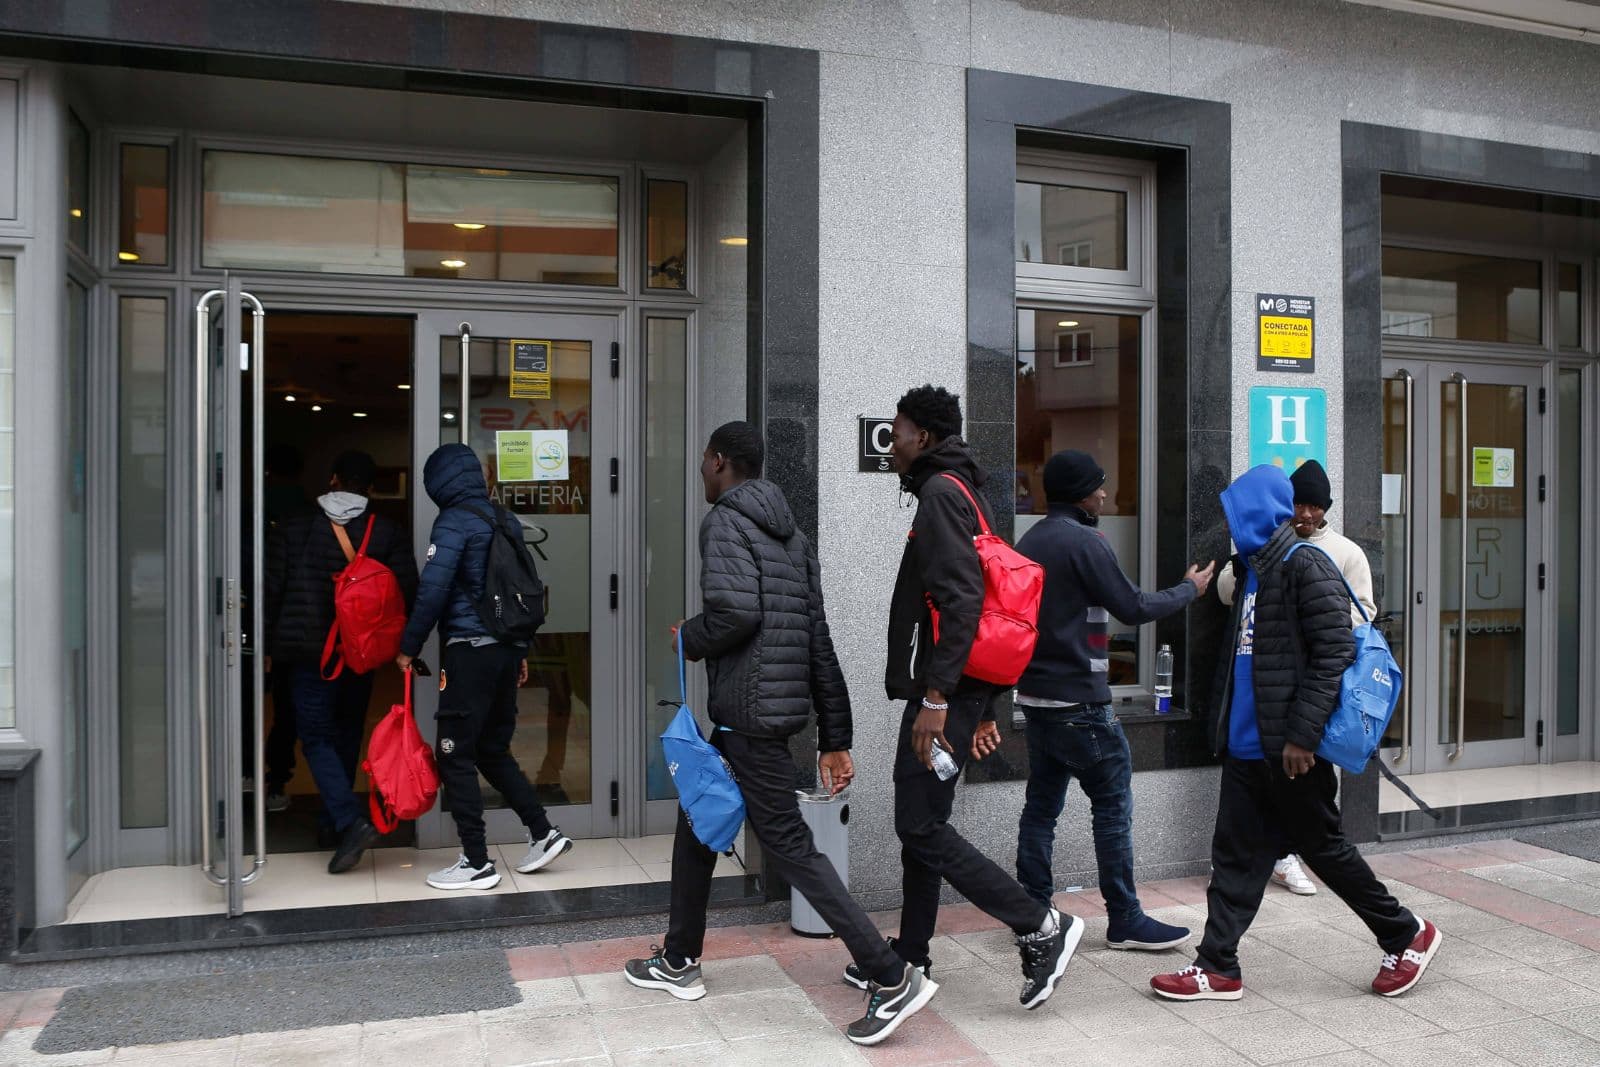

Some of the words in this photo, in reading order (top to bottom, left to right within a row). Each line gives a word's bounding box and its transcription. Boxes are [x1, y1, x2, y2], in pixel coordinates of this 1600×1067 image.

[1264, 322, 1308, 331] CONECTADA
[1266, 395, 1311, 444] H
[502, 440, 529, 448] prohibido
[489, 485, 584, 505] AFETERIA
